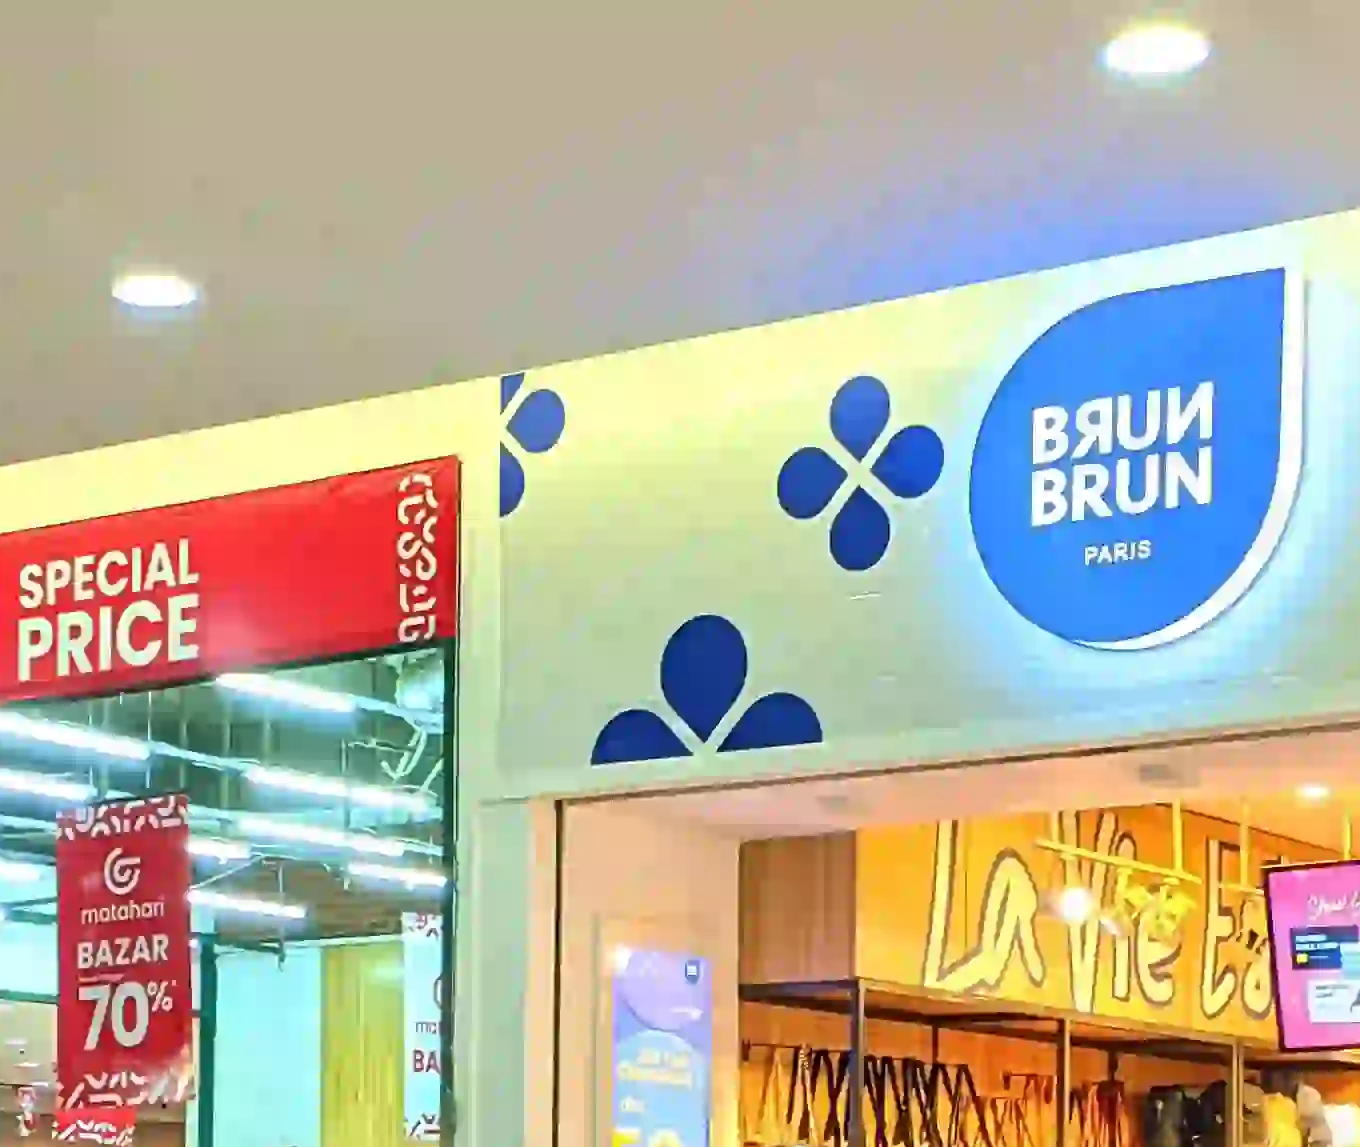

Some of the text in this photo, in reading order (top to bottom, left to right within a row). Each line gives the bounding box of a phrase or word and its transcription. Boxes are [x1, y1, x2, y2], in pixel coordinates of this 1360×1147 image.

[1030, 446, 1214, 527] BRUN
[18, 537, 200, 609] SPECIAL
[1083, 538, 1153, 566] PARIS
[17, 592, 200, 683] PRICE
[81, 896, 165, 925] matahari
[77, 933, 169, 970] BAZAR
